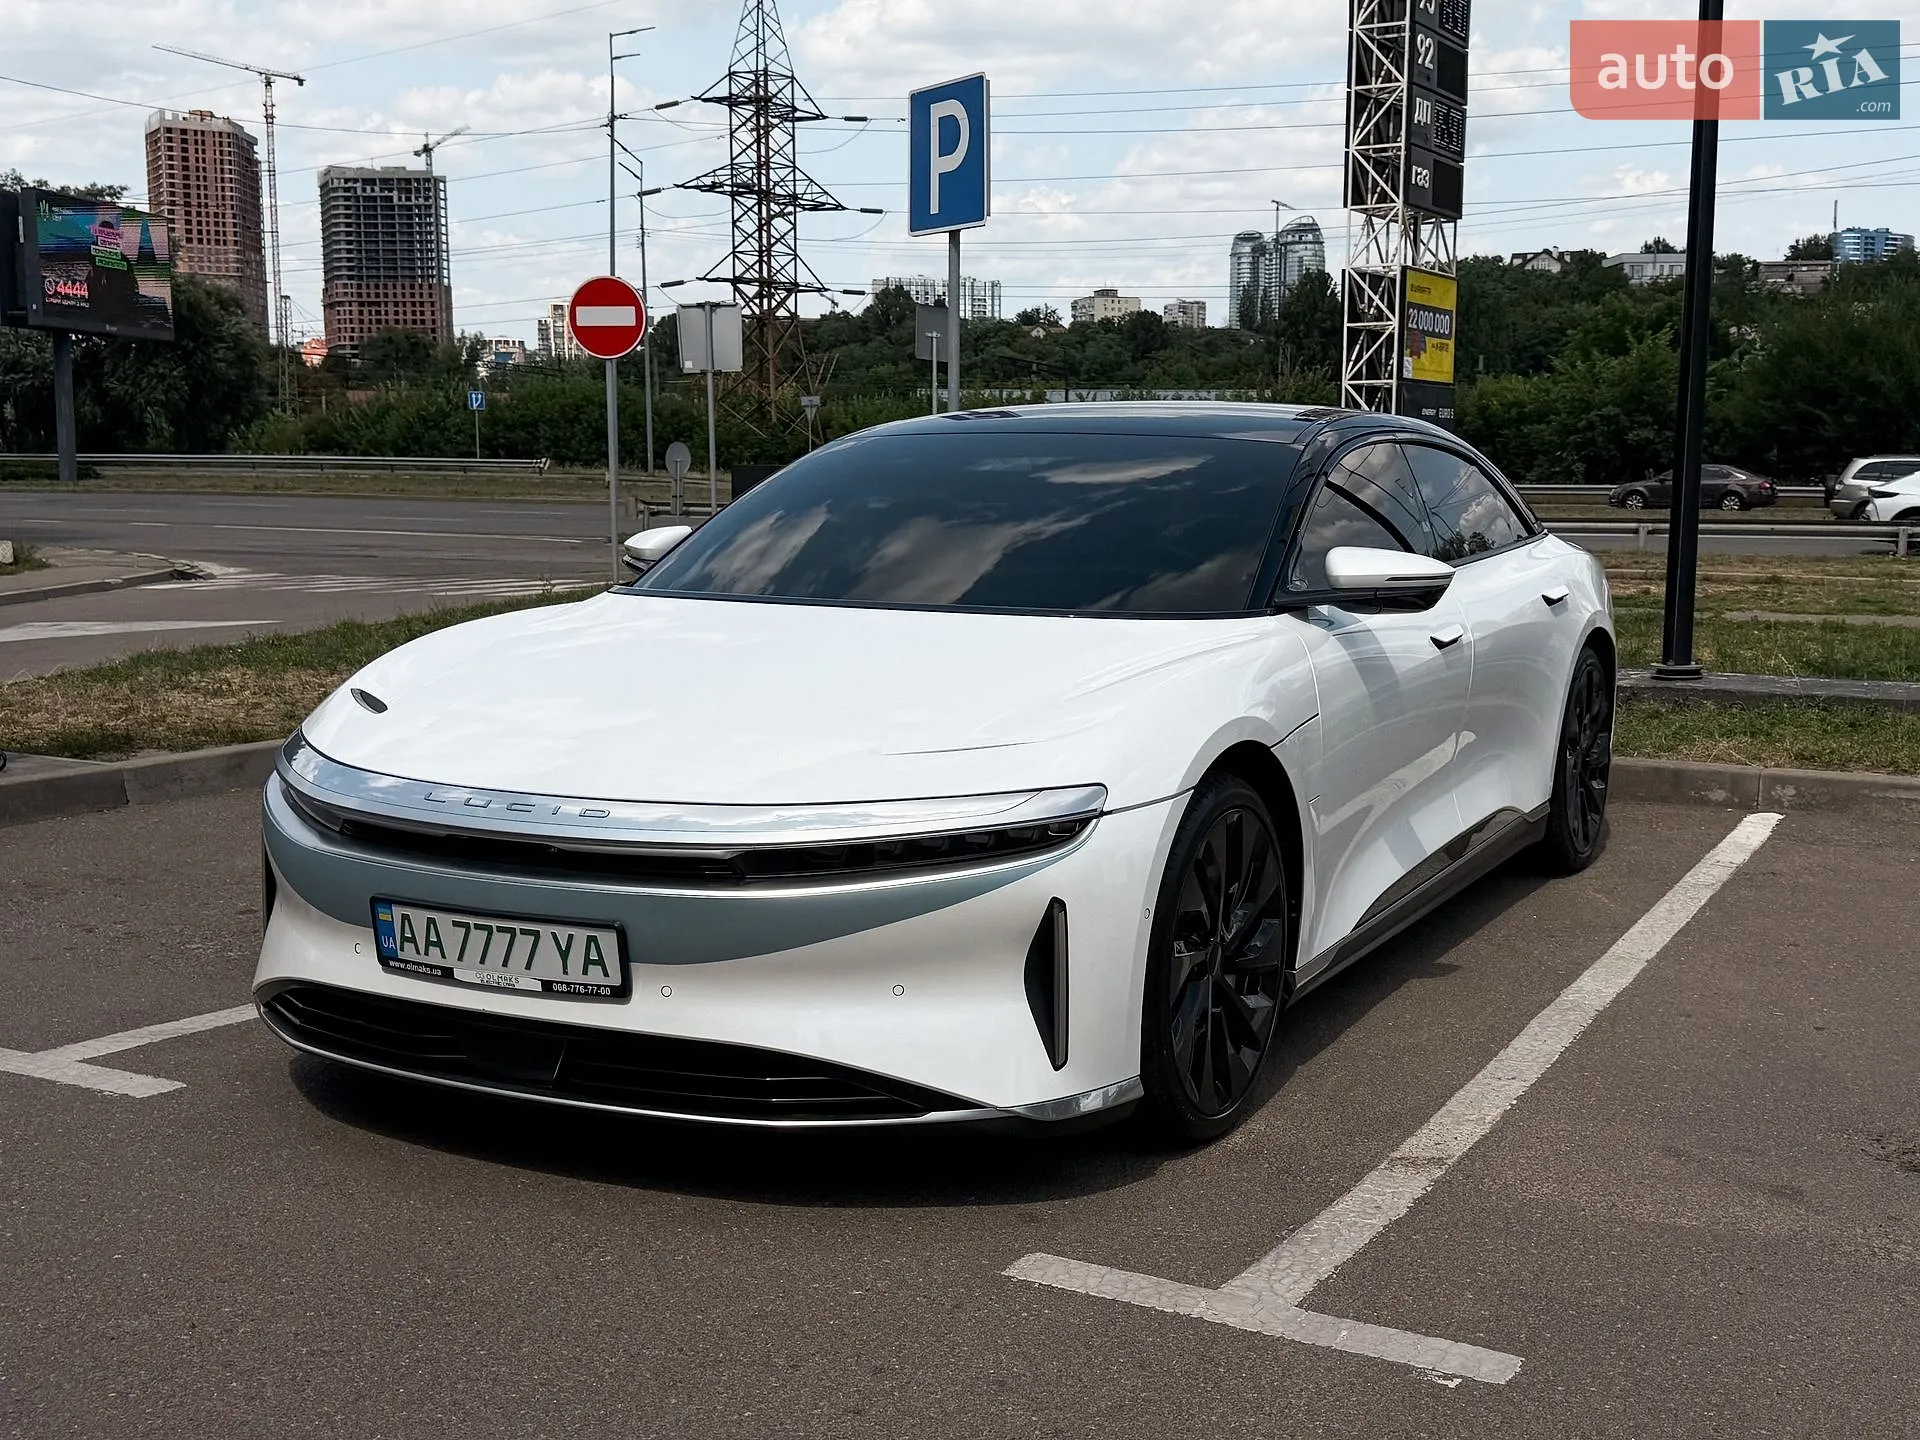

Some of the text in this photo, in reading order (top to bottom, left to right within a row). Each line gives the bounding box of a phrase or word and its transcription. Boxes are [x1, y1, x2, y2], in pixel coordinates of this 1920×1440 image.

[1416, 33, 1434, 70] 92
[1414, 97, 1431, 126] ДП
[930, 99, 970, 215] P
[56, 279, 88, 299] 4444
[1408, 308, 1450, 335] 22 000 000
[1438, 408, 1450, 419] EURO
[424, 791, 610, 819] LUCID
[382, 935, 396, 950] UA
[389, 959, 442, 976] www.olmaks.ua
[486, 973, 520, 984] OLMAKS
[552, 983, 611, 996] 068-776-77-00
